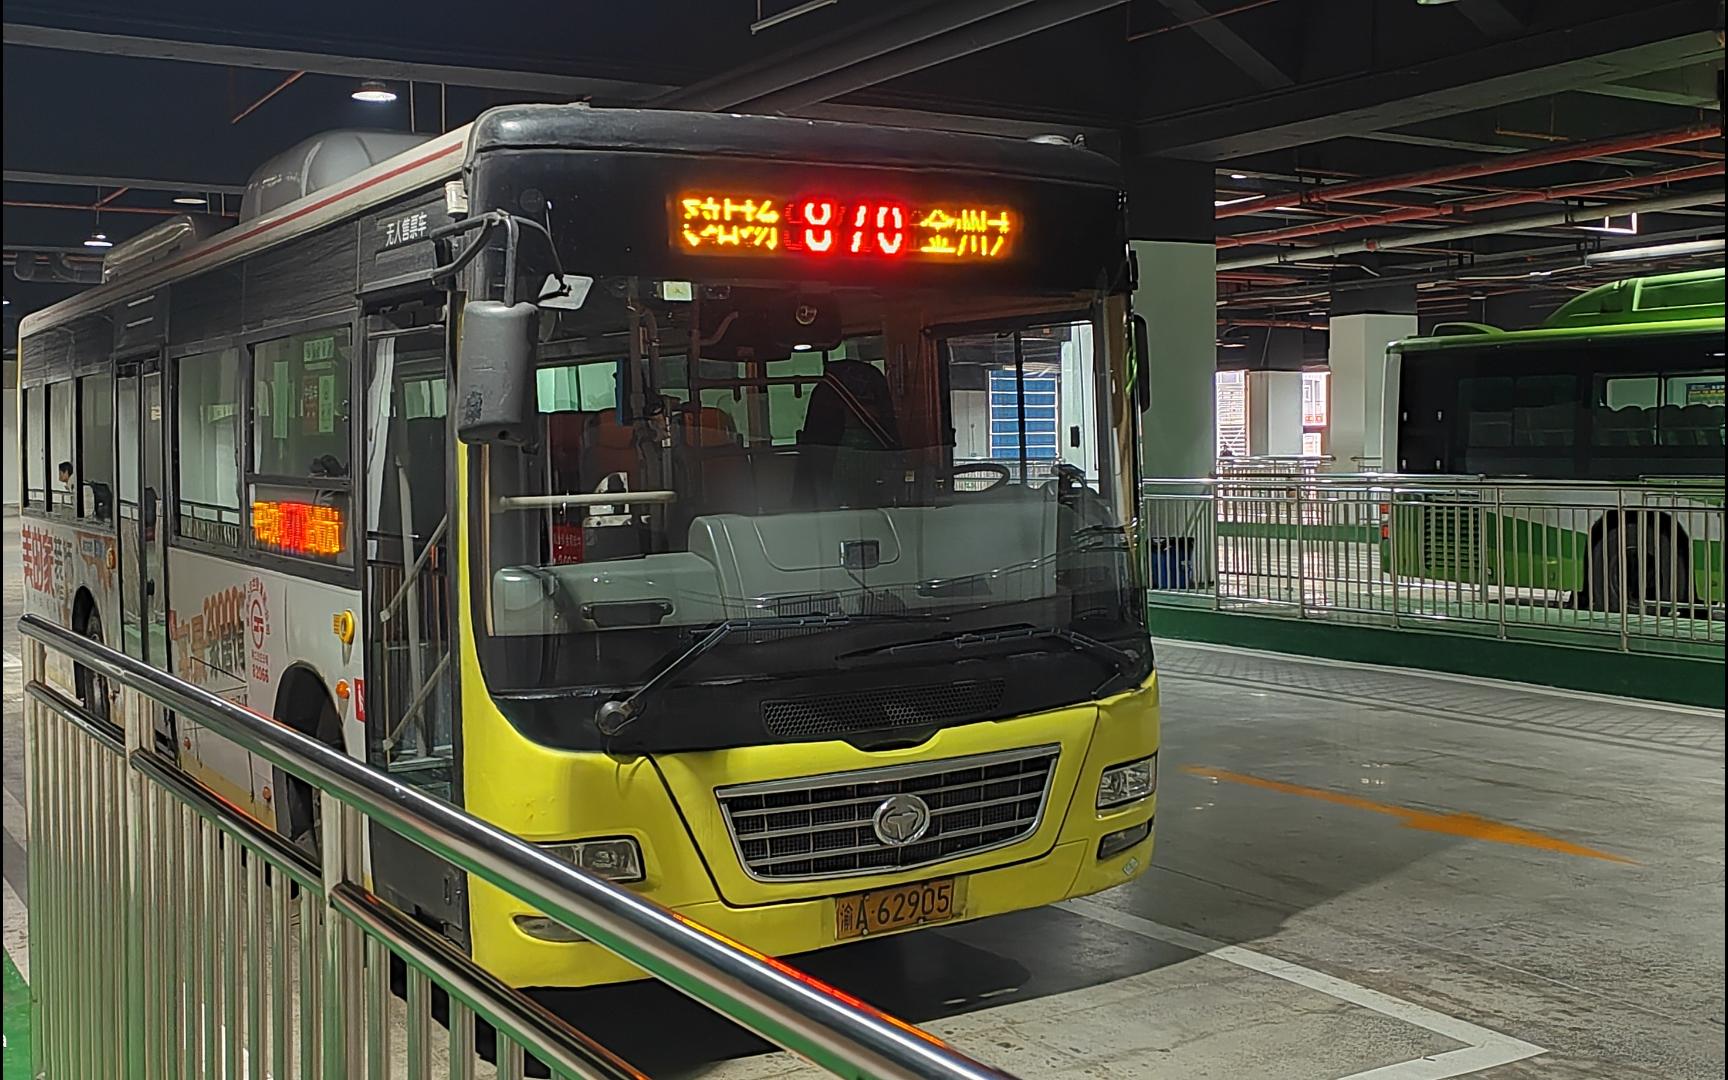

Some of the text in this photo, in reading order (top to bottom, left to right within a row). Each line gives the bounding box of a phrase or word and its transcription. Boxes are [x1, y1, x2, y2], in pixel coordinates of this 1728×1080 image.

[386, 211, 427, 247] 无人售票车
